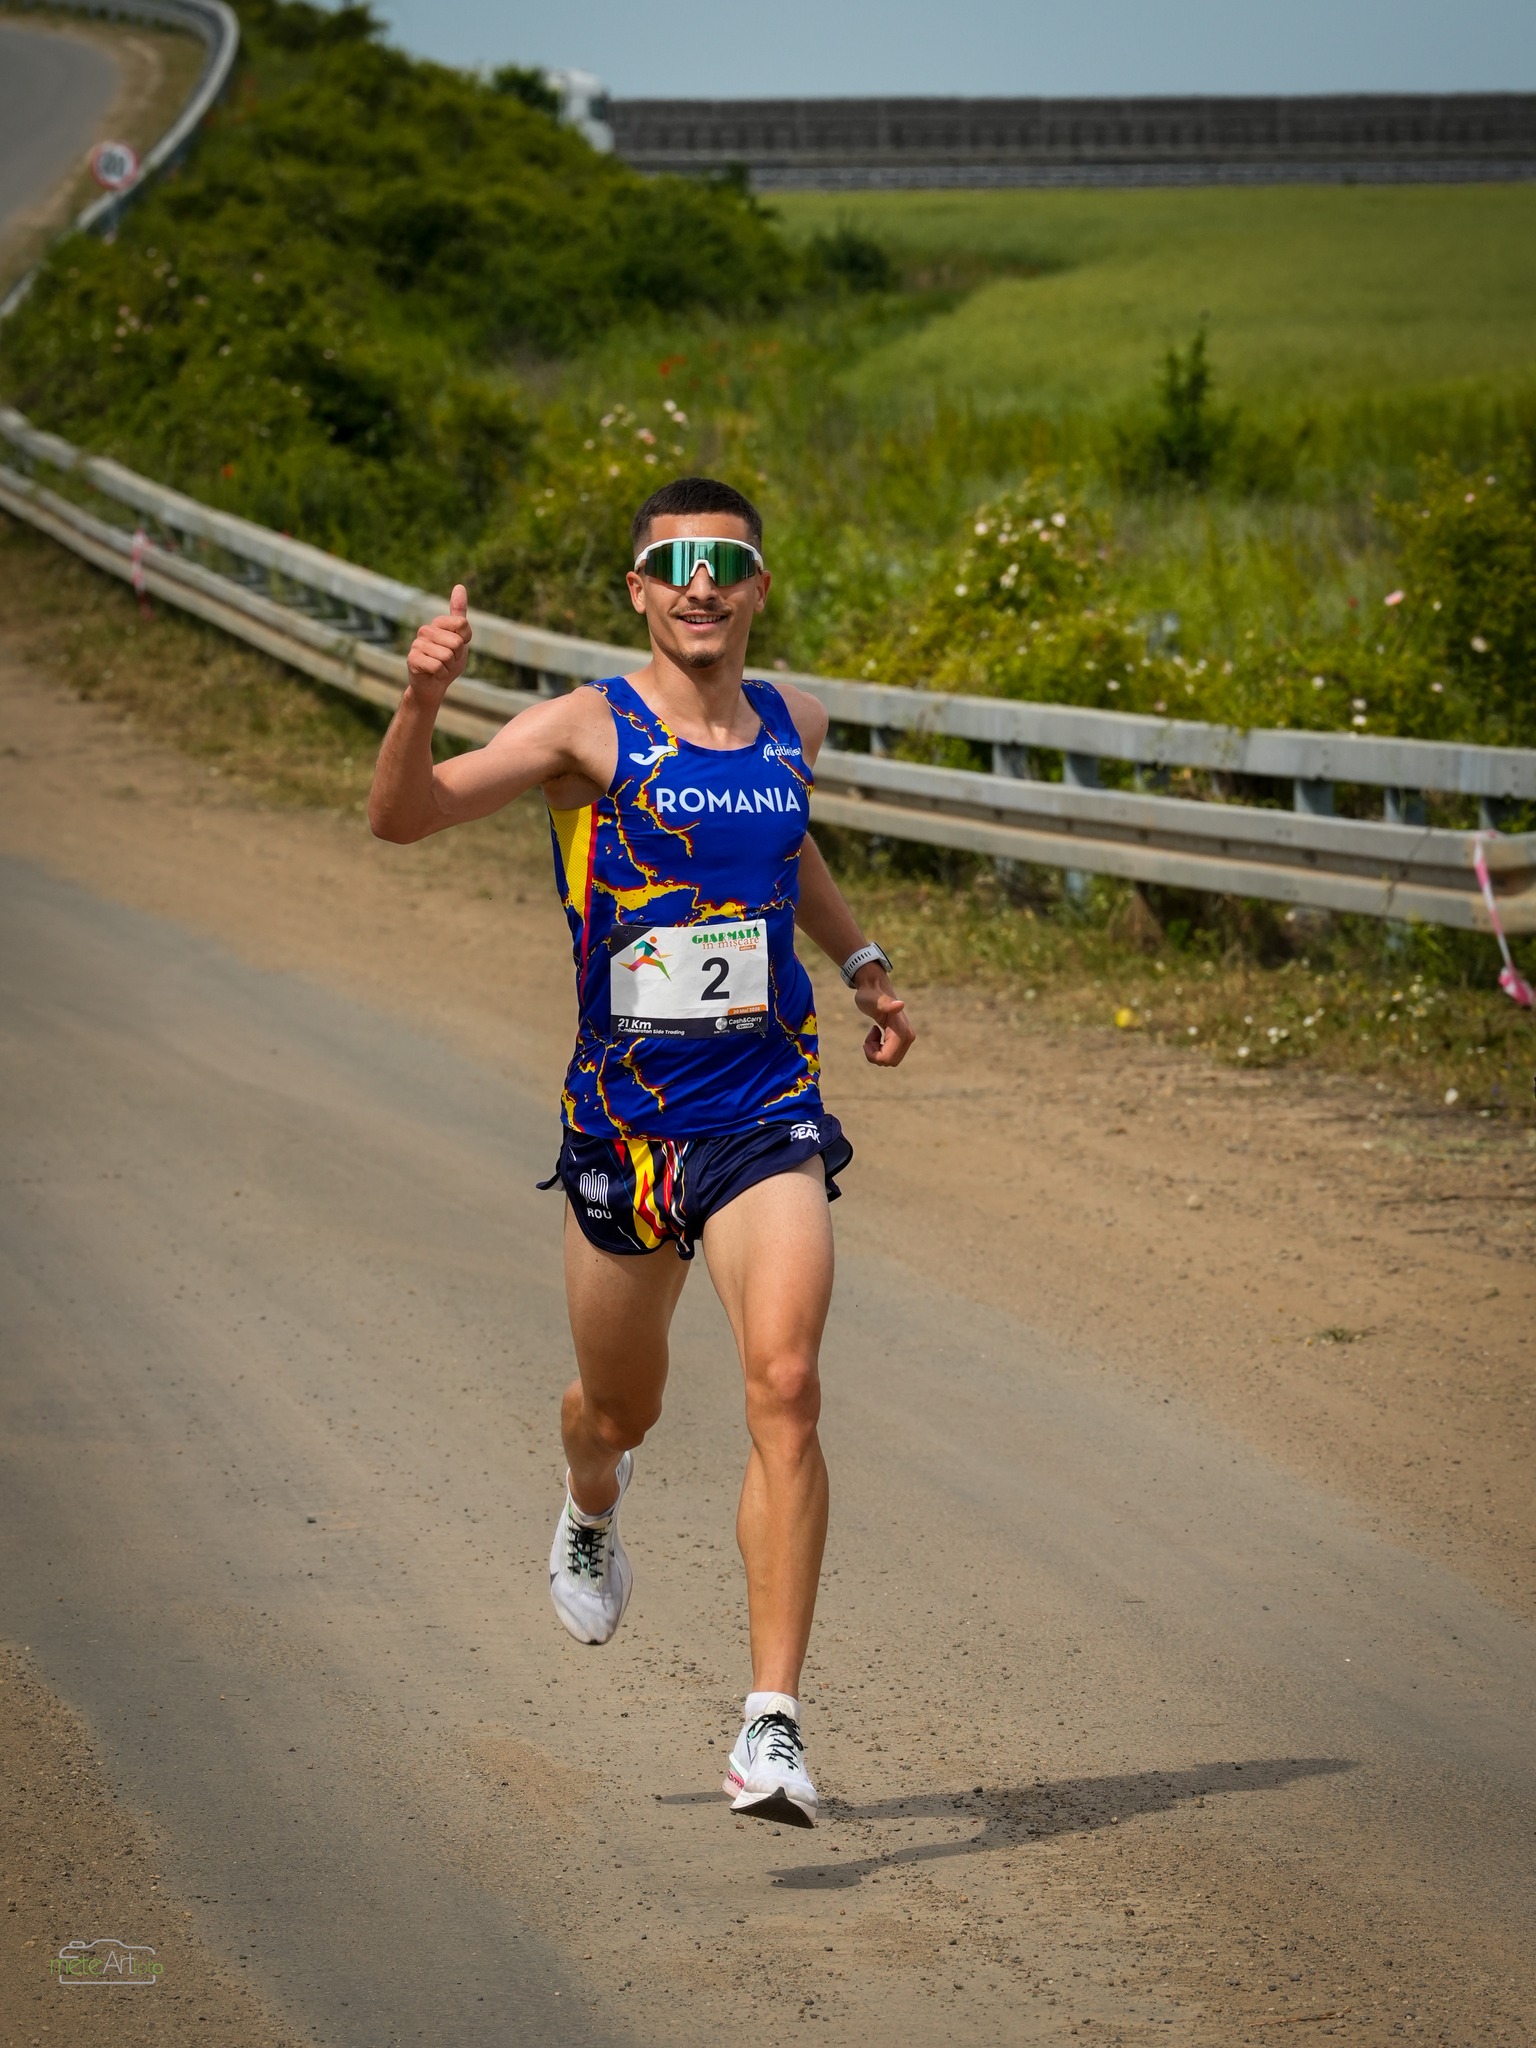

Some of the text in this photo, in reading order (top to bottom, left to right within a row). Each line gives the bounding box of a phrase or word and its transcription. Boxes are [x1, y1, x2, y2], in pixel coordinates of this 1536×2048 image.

[656, 787, 801, 813] ROMANIA
[692, 928, 760, 944] GIARMATA
[701, 957, 730, 1001] 2
[617, 1018, 652, 1029] 21 Km
[729, 1016, 763, 1025] Cash&Carry
[790, 1127, 821, 1144] PEAK
[587, 1207, 612, 1219] ROU
